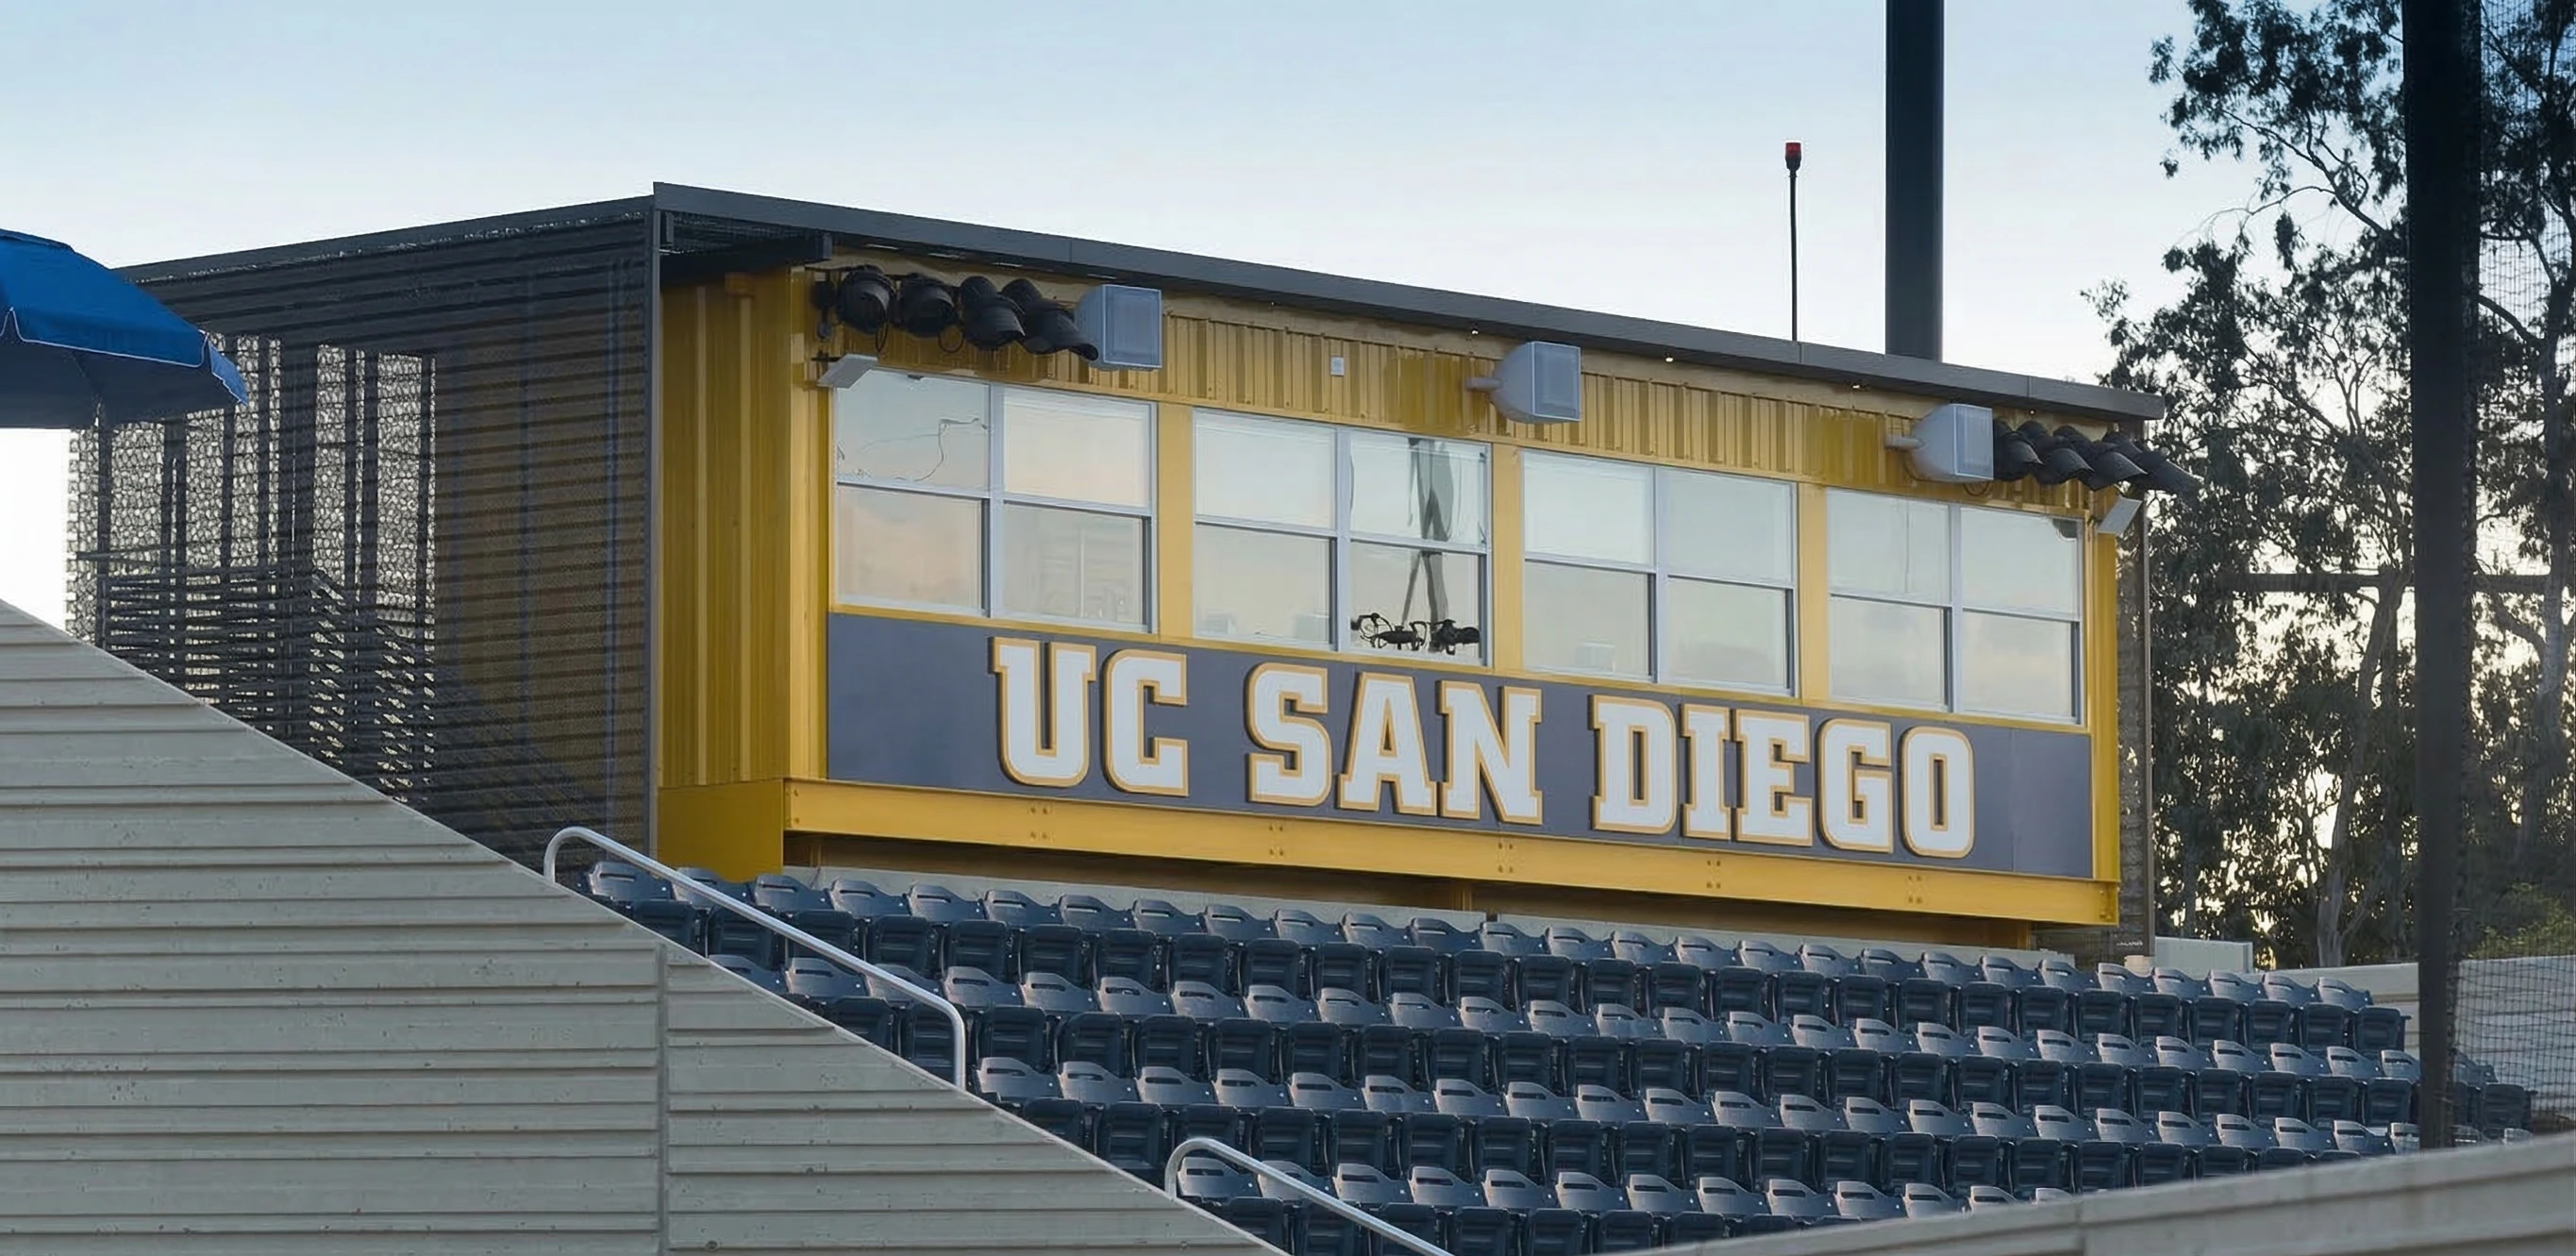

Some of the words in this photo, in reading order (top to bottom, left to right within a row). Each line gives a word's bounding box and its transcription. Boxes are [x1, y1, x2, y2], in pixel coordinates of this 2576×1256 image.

[991, 637, 1189, 795] UC
[1247, 662, 1543, 825] SAN
[1591, 695, 1975, 859] DIEGO
